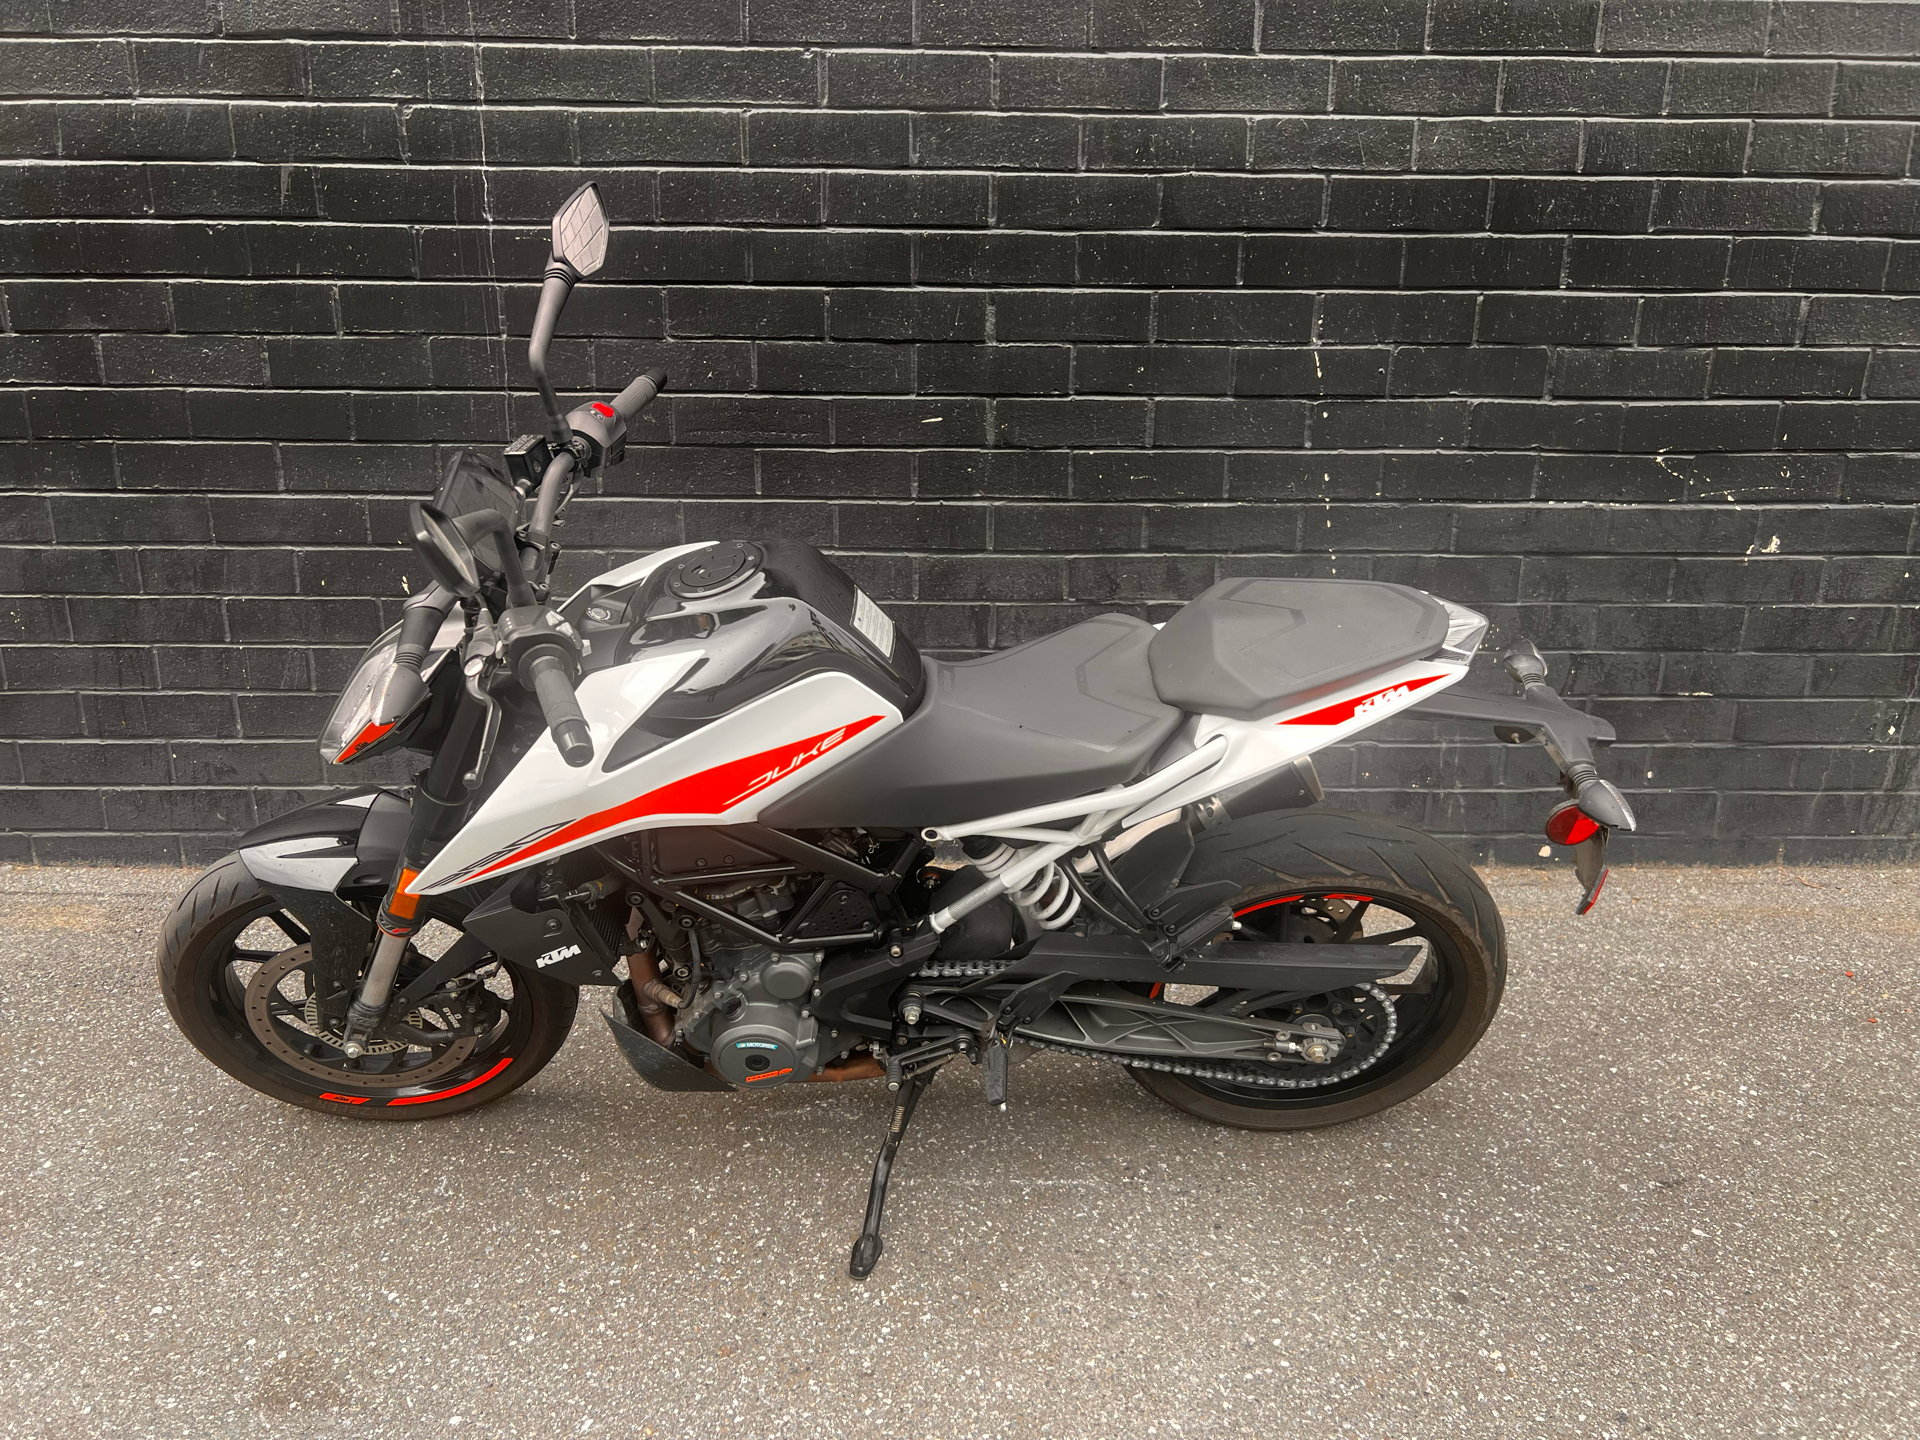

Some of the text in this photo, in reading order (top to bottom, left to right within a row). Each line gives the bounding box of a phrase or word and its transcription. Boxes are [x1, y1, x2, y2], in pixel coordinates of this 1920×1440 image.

[1354, 685, 1410, 717] KTM
[722, 727, 846, 805] DUKE
[535, 944, 581, 968] KTM
